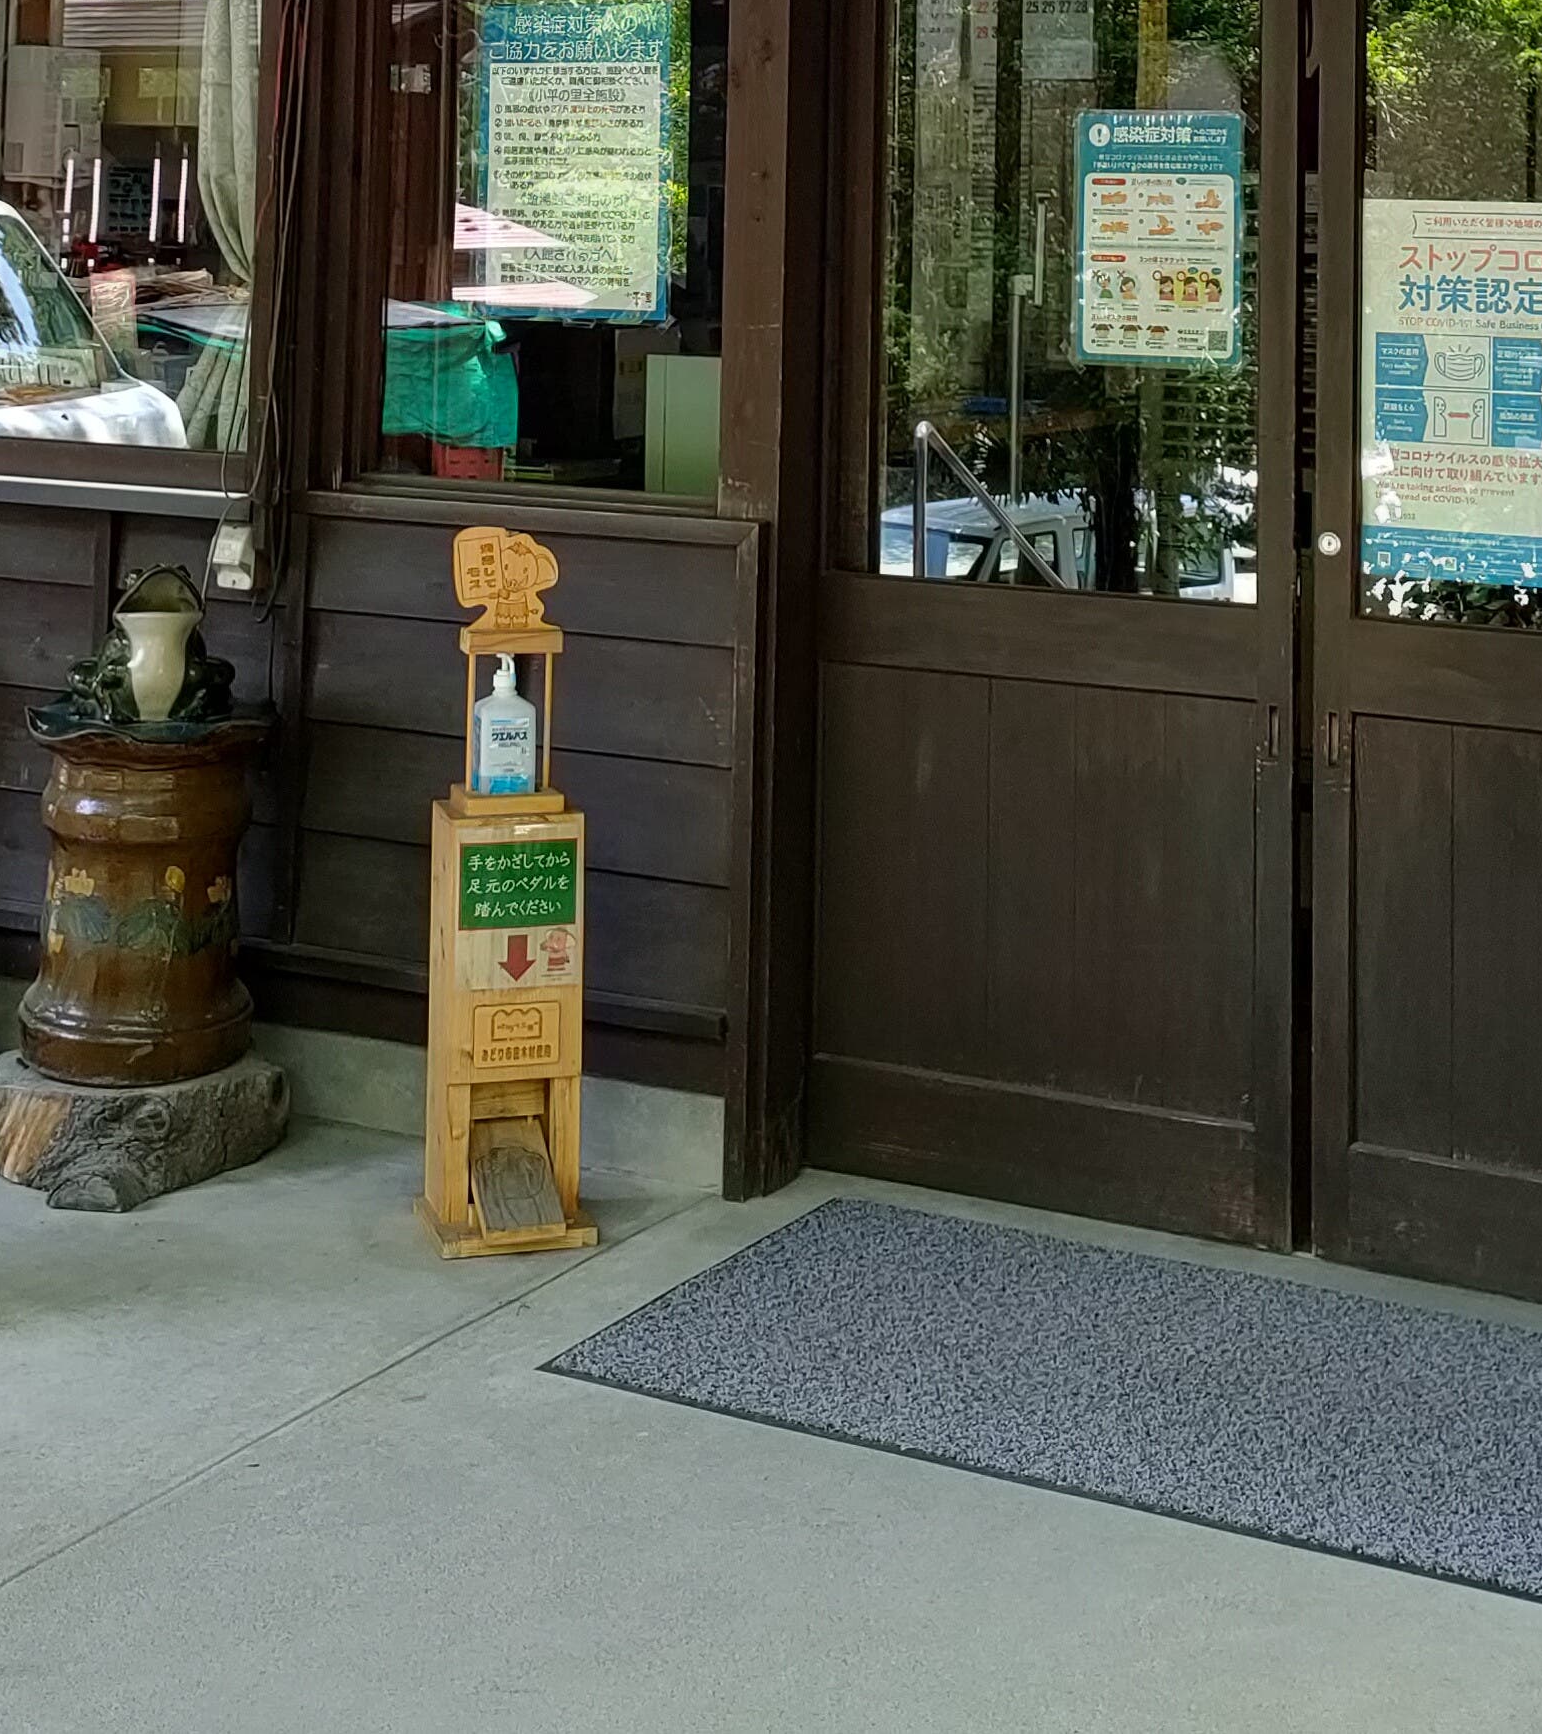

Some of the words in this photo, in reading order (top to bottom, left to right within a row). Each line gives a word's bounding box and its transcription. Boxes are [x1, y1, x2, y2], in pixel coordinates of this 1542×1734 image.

[1026, 0, 1040, 13] 25
[1042, 0, 1056, 13] 26
[1058, 0, 1072, 13] 27
[514, 12, 637, 37] 感染症対策への
[489, 39, 663, 62] ご協力をお願いします
[1113, 126, 1193, 145] 感染症対策
[1475, 317, 1497, 330] Safe
[1499, 319, 1540, 332] Business
[1406, 481, 1433, 494] taking
[467, 850, 572, 872] 手をかざしてから
[466, 874, 571, 895] 足元のペダルを
[473, 898, 563, 919] 踏んでください
